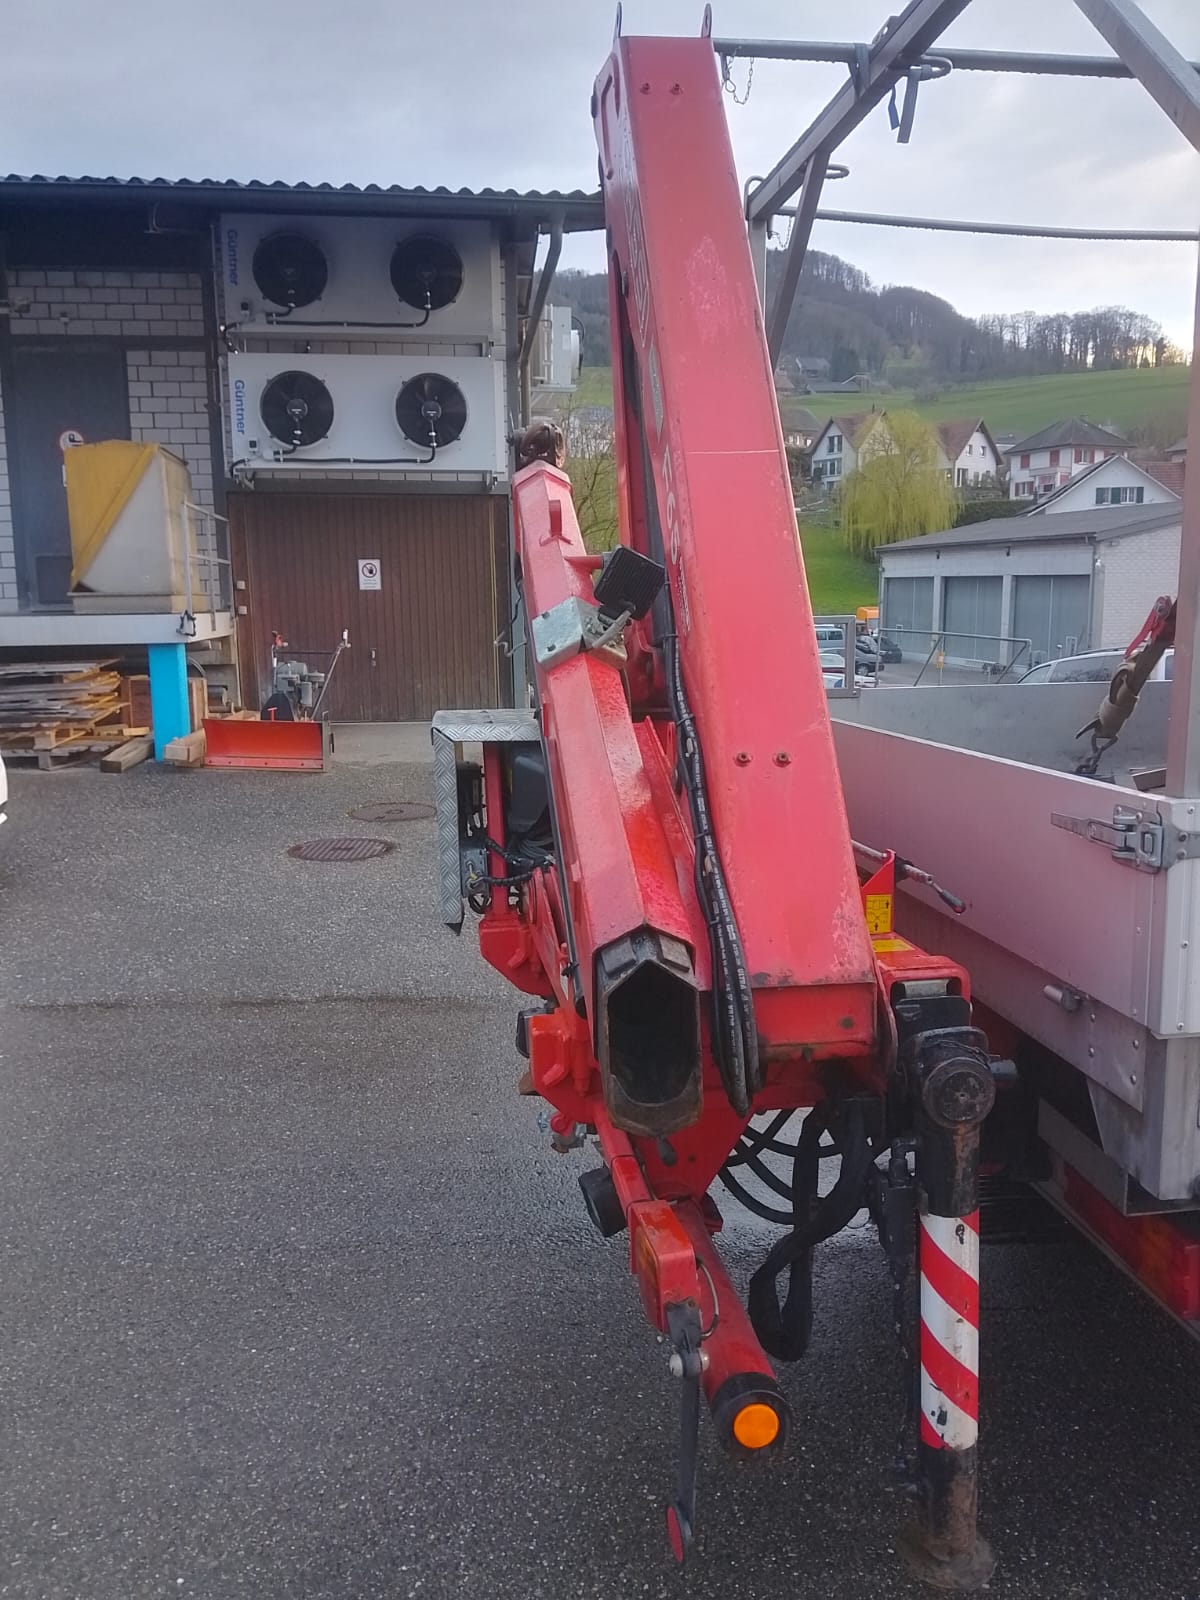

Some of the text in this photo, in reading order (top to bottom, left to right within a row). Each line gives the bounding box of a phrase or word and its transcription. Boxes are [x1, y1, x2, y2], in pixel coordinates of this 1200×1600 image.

[227, 229, 238, 286] Güntner
[234, 379, 245, 435] Güntner
[662, 444, 680, 565] F65
